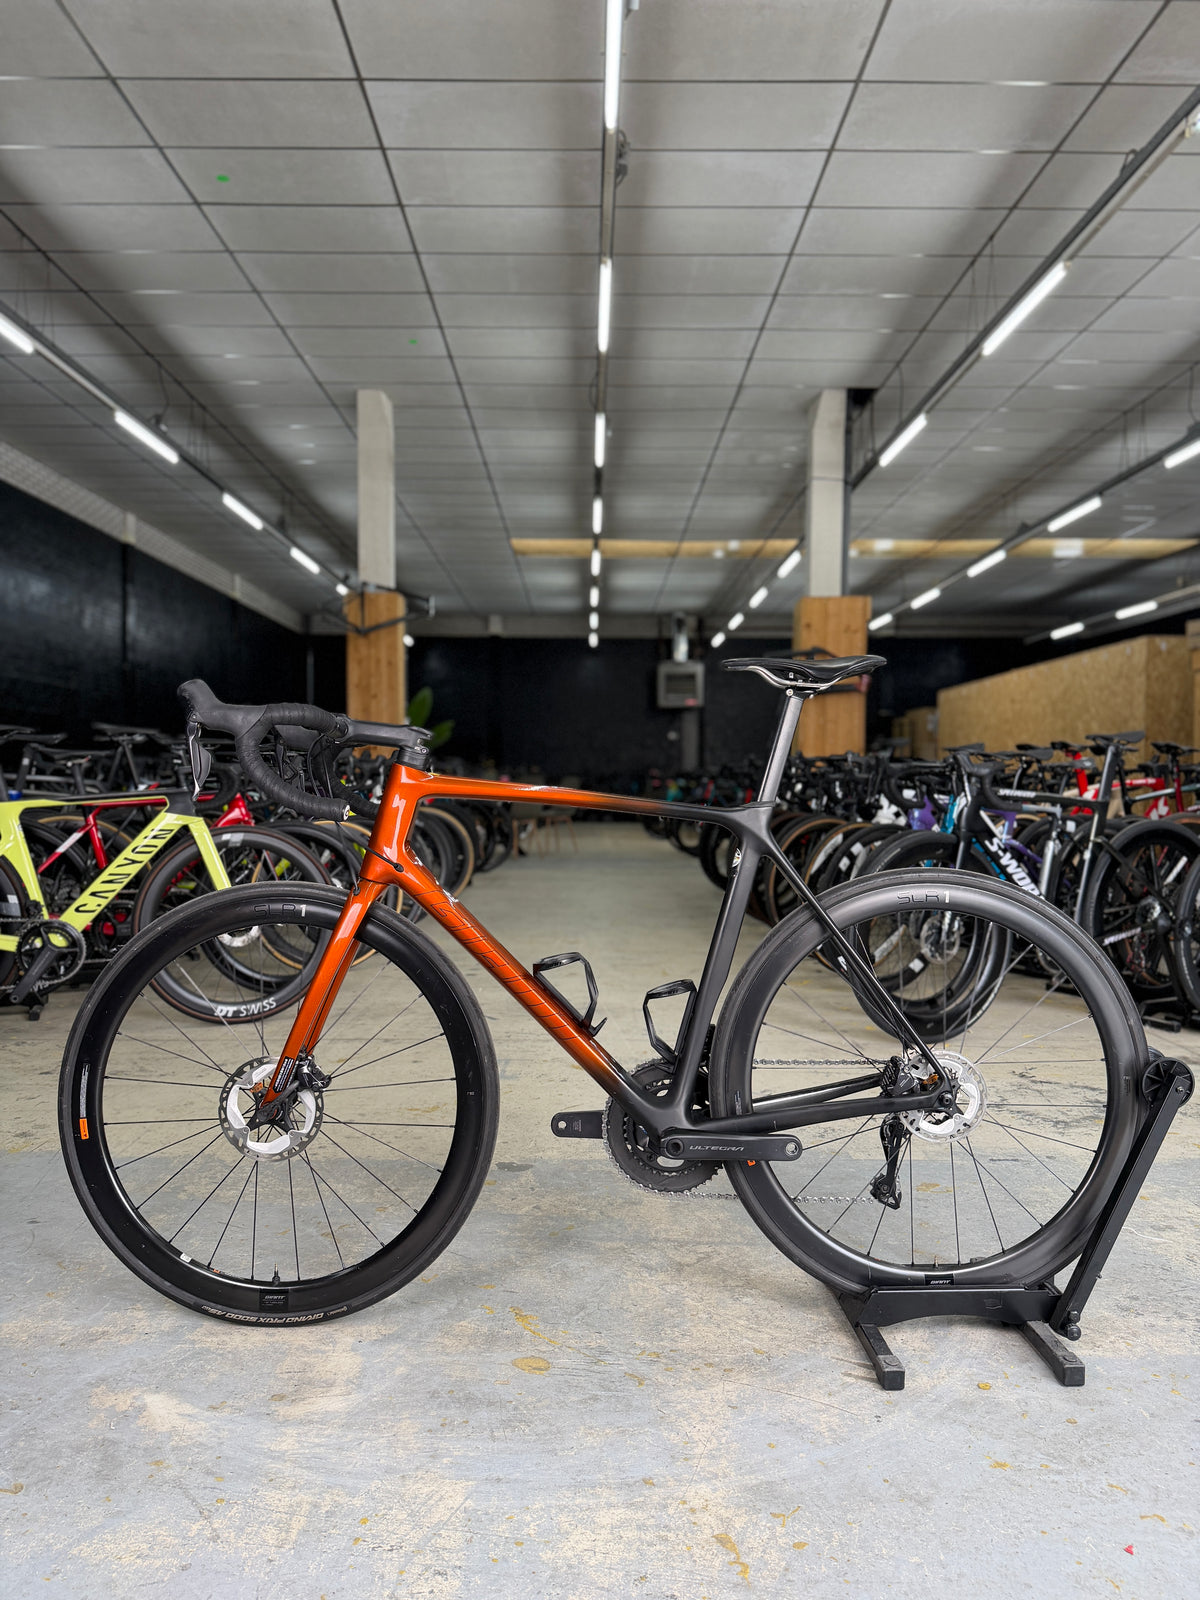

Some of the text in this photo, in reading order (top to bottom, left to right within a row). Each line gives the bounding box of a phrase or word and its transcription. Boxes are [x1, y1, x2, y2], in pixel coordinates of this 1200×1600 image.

[74, 829, 175, 913] CANYON
[984, 837, 1041, 897] S-WOR
[214, 997, 277, 1017] DT SWISS
[225, 1312, 258, 1322] 5000
